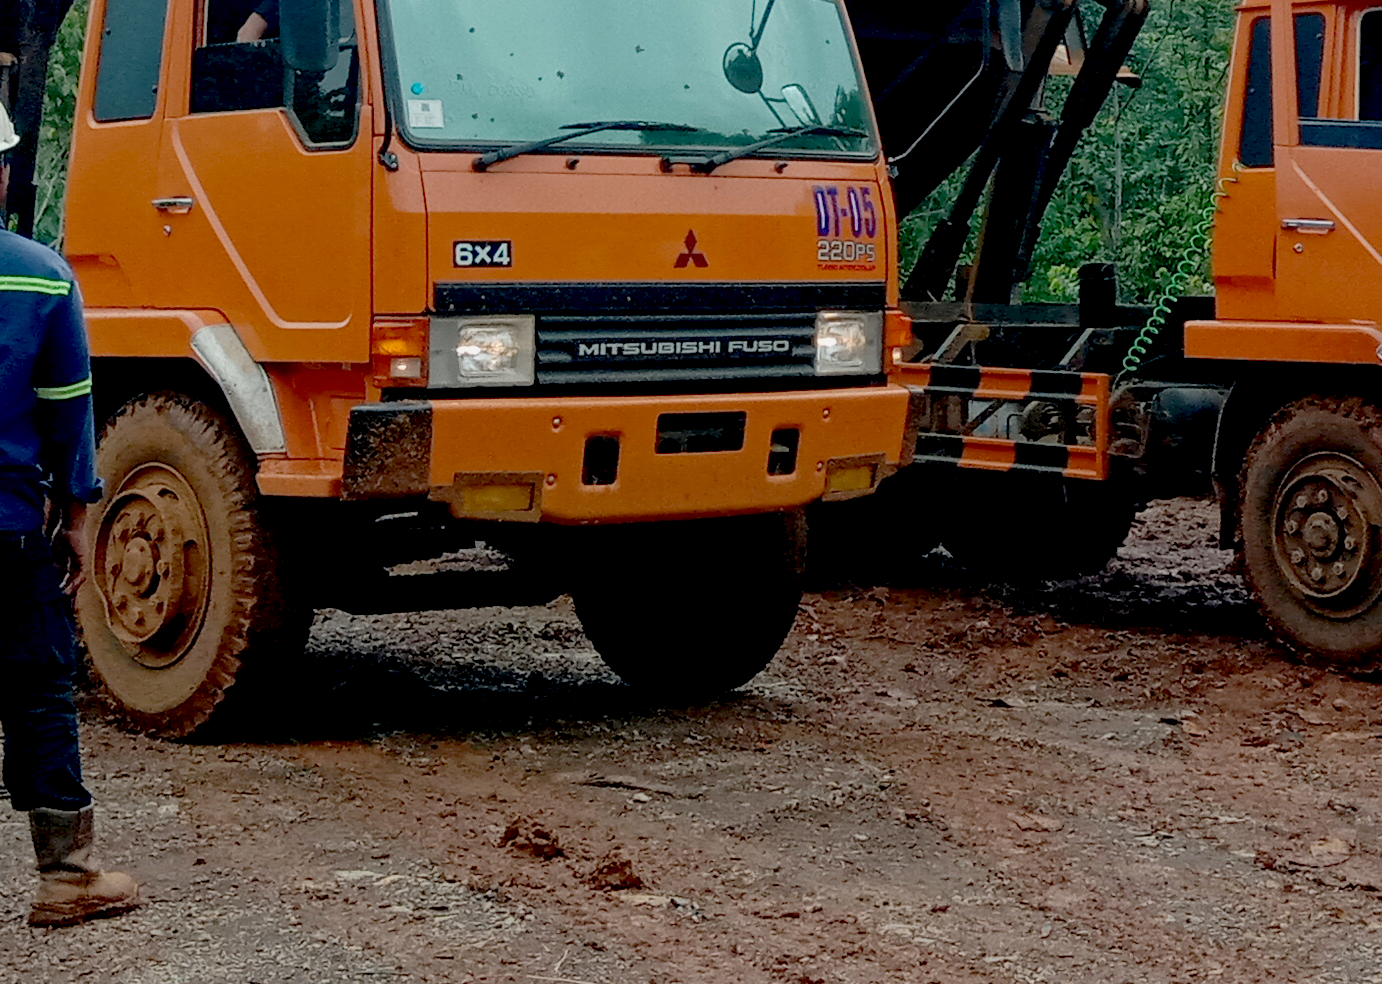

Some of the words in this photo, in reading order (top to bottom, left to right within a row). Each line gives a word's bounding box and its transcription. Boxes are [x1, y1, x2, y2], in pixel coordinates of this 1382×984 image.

[812, 185, 876, 238] DT-05
[817, 239, 876, 263] 220PS
[578, 340, 721, 356] MITSUBISHI
[728, 339, 790, 353] FUSO
